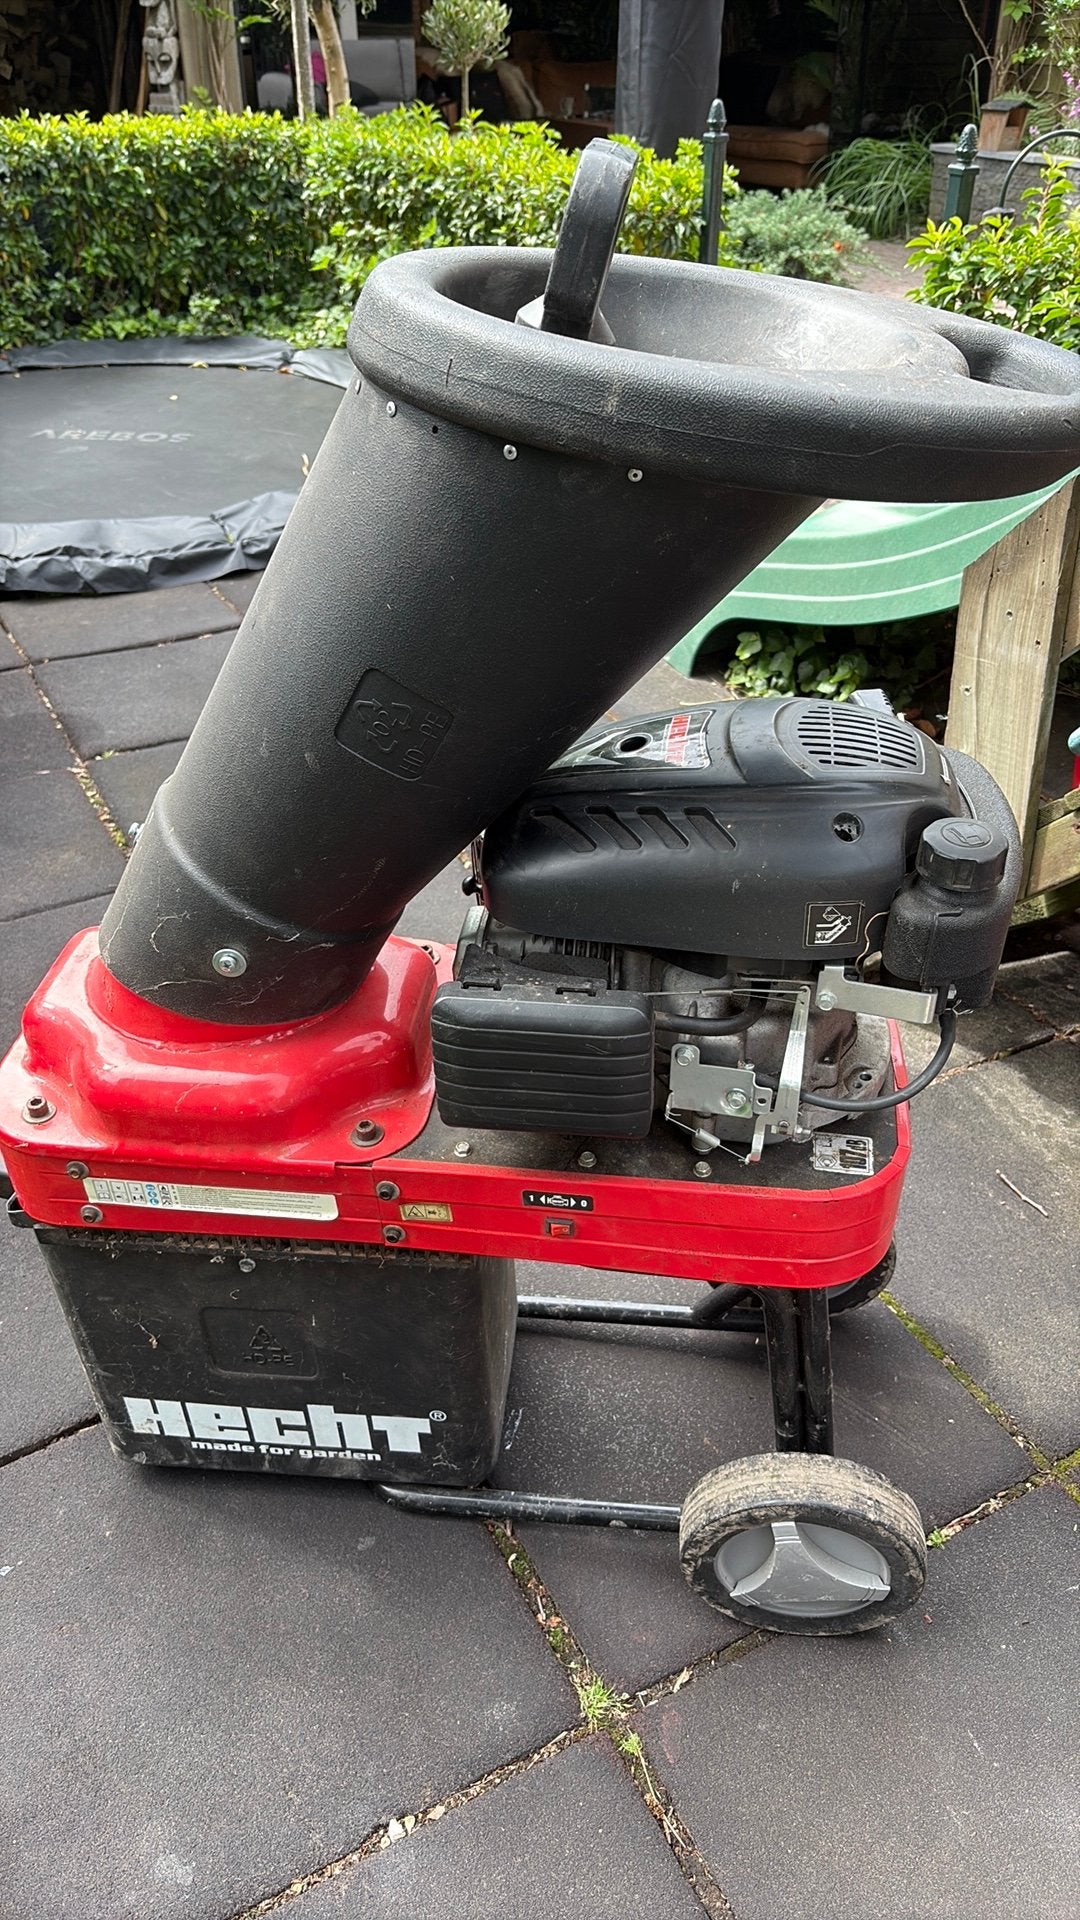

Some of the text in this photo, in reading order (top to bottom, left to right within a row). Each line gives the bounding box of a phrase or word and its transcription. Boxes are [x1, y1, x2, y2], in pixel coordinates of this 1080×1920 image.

[27, 428, 196, 443] AREBOS
[399, 711, 449, 775] HD-PE
[190, 1440, 382, 1462] made for garden
